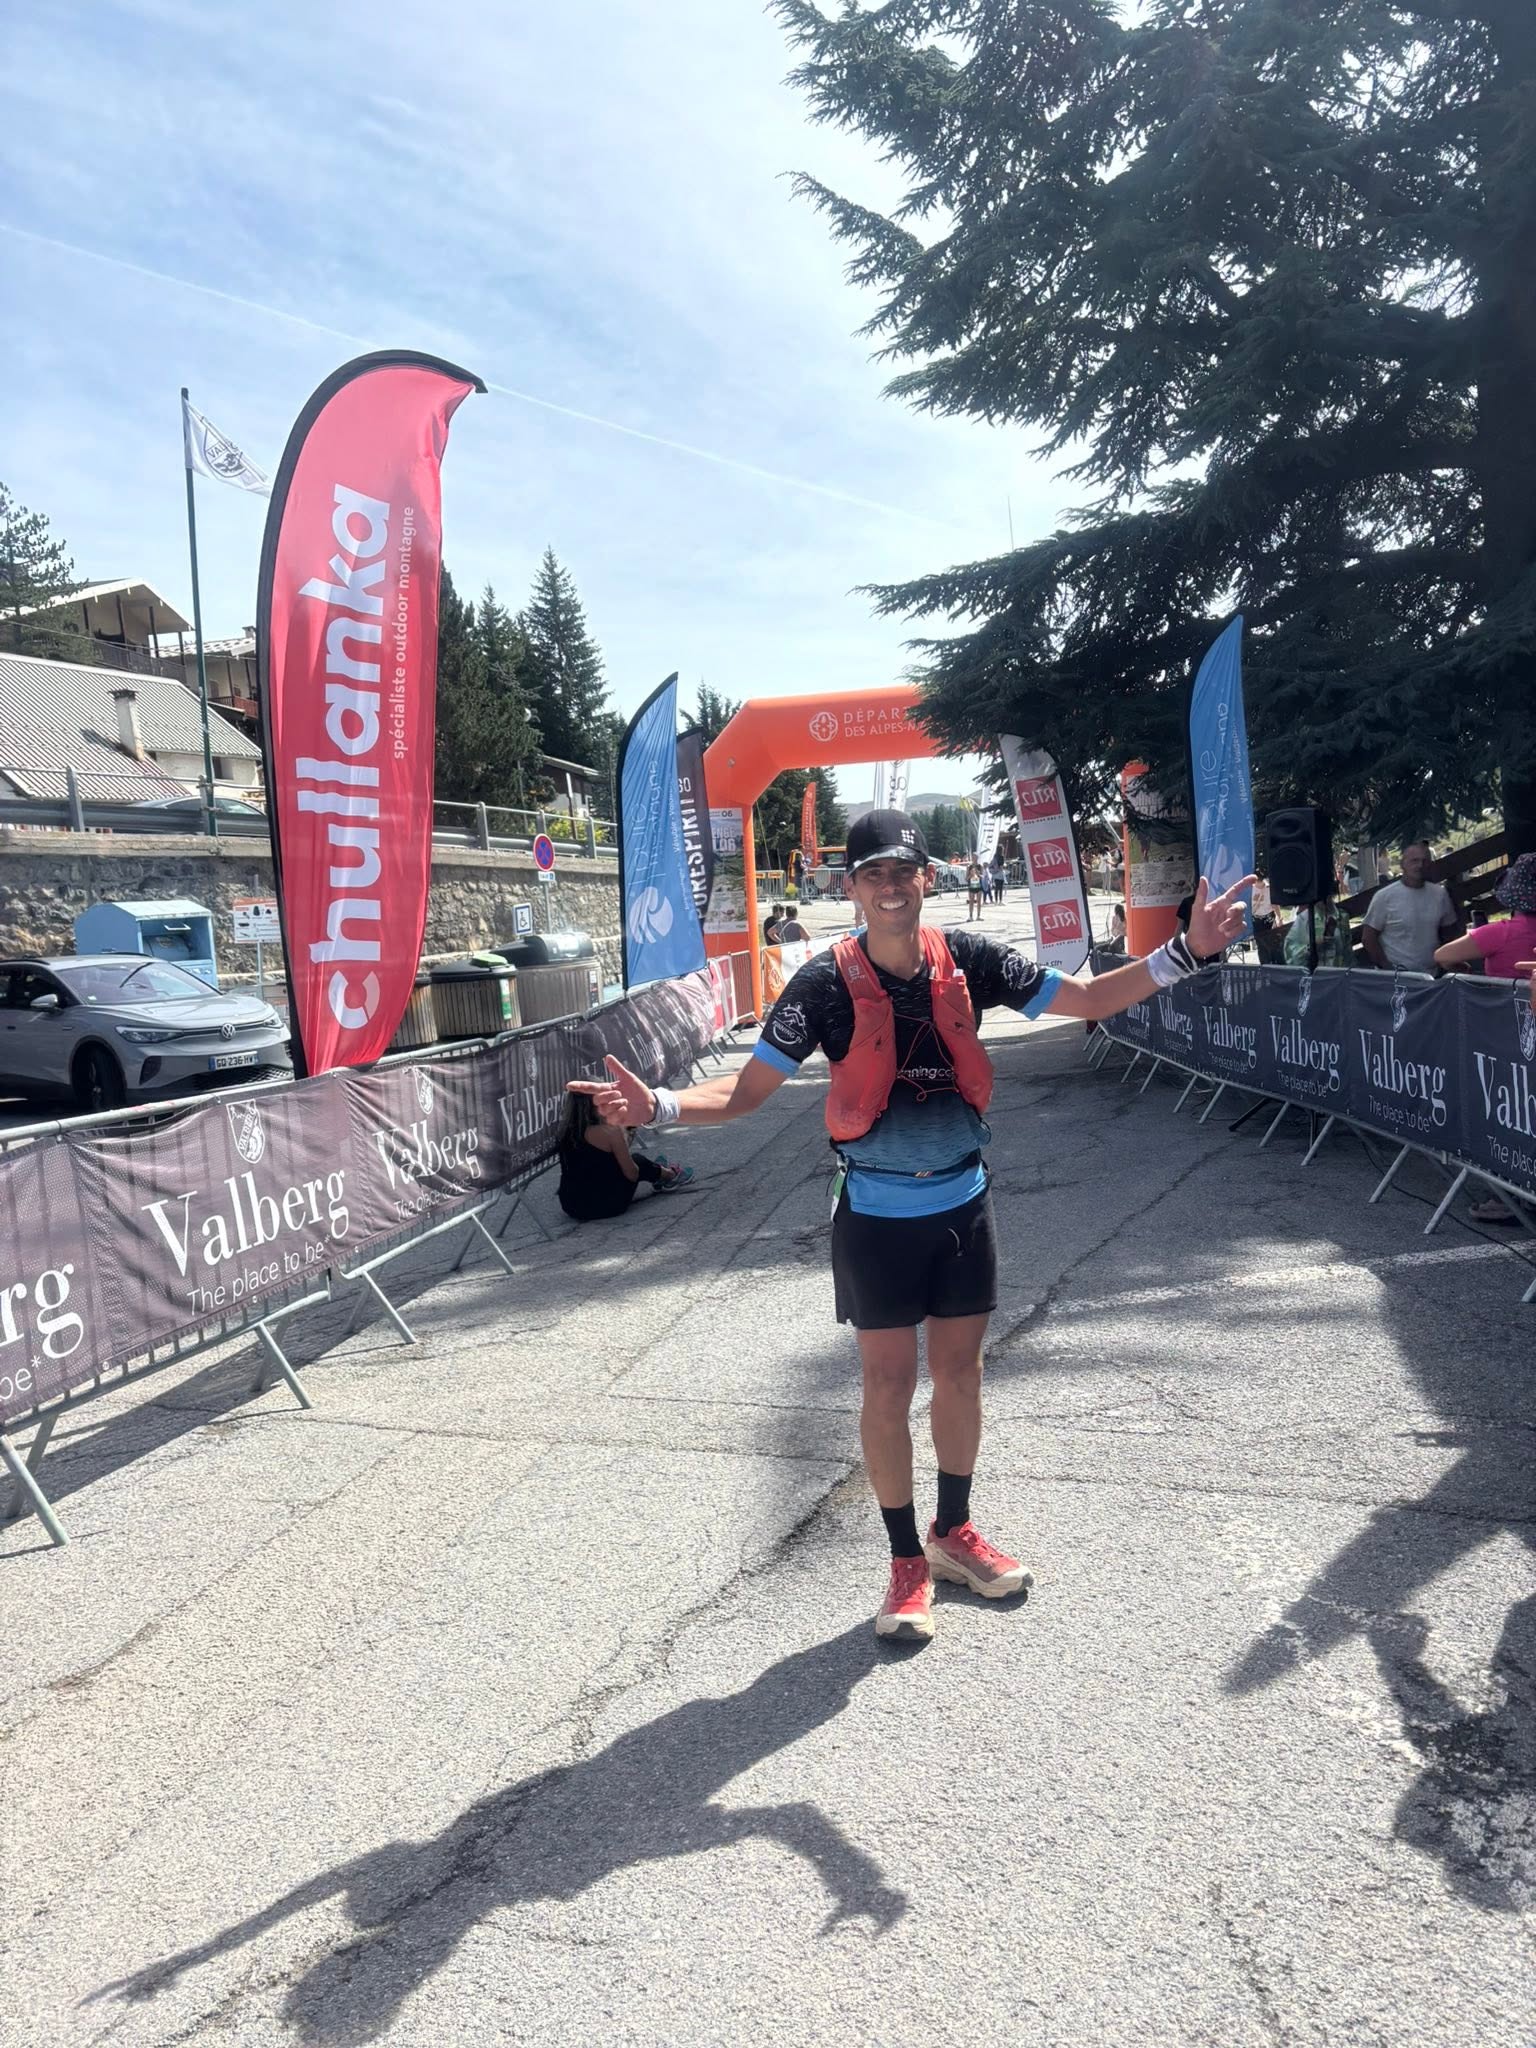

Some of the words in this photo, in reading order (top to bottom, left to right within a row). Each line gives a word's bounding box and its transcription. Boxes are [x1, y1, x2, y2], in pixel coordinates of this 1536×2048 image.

[399, 506, 417, 589] montagne
[392, 593, 409, 662] outdoor
[389, 668, 408, 760] spécialiste
[844, 706, 908, 724] DÉPAR
[845, 725, 866, 738] DES
[296, 484, 391, 1031] chullanka
[1202, 1006, 1257, 1069] Valberg
[1269, 1015, 1340, 1091] Valberg
[1358, 1029, 1447, 1126] Valberg
[1473, 1051, 1536, 1138] Valb
[372, 1120, 482, 1190] Valberg
[1487, 1135, 1509, 1164] The
[141, 1170, 349, 1277] Valberg
[0, 1263, 84, 1359] rg
[187, 1285, 226, 1316] The
[231, 1262, 279, 1303] place
[283, 1250, 300, 1274] to
